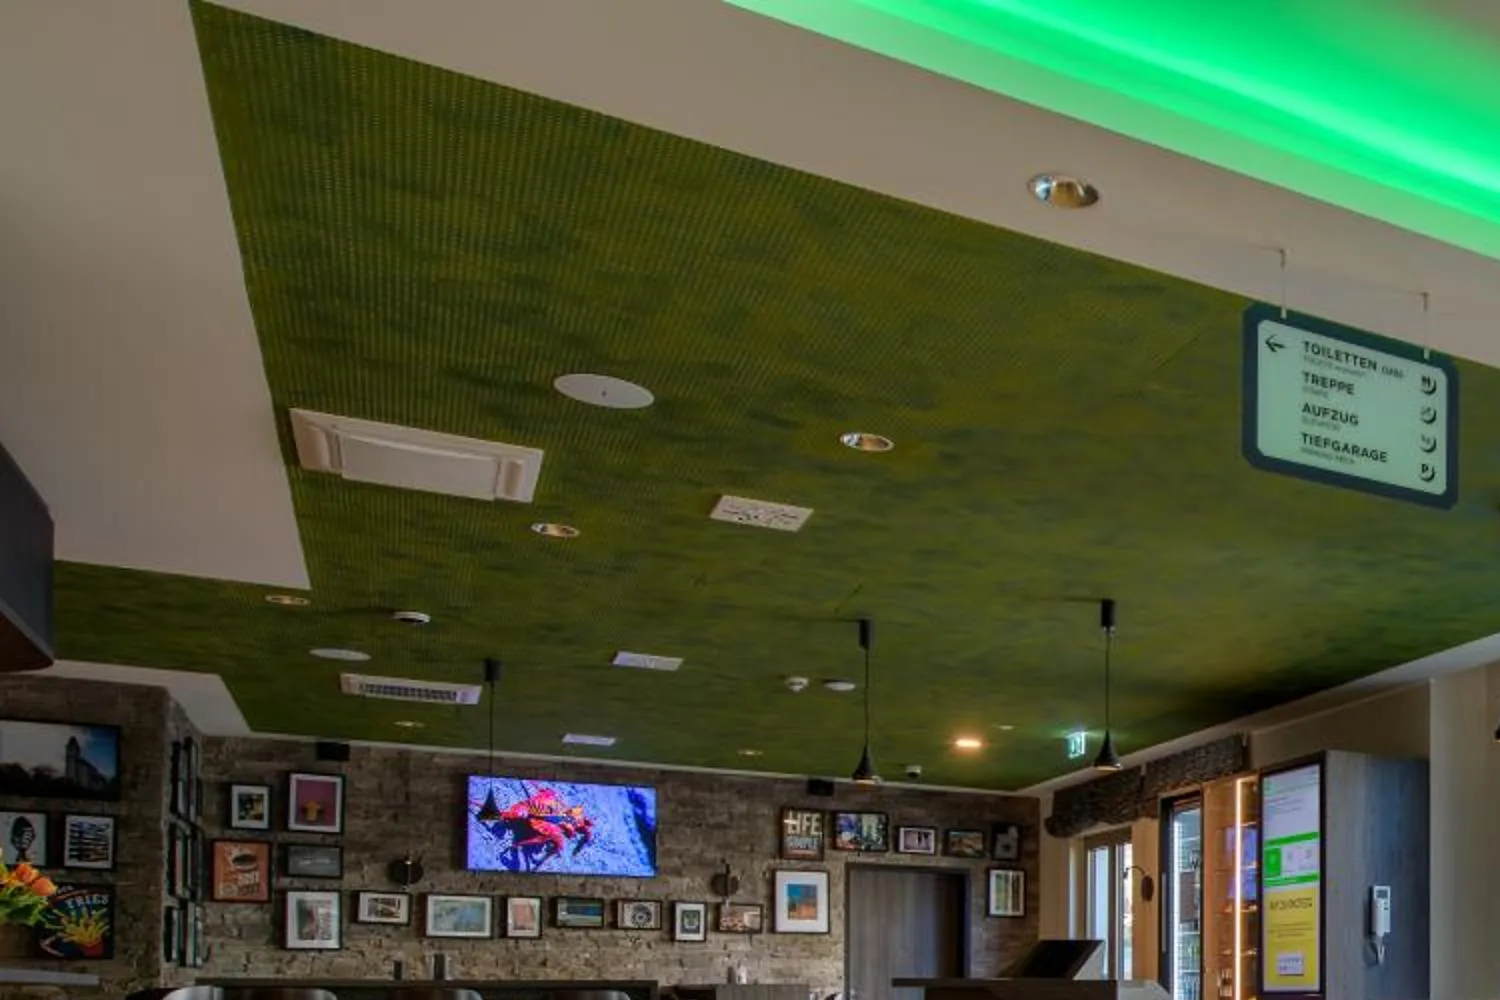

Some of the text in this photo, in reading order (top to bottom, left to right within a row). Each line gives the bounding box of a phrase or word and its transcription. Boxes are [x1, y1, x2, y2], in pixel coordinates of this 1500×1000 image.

[1302, 340, 1377, 371] TOILETTEN
[1302, 372, 1355, 395] TREPPE
[1302, 402, 1359, 426] AUFZUG
[1302, 432, 1388, 462] TIEFGARAGE
